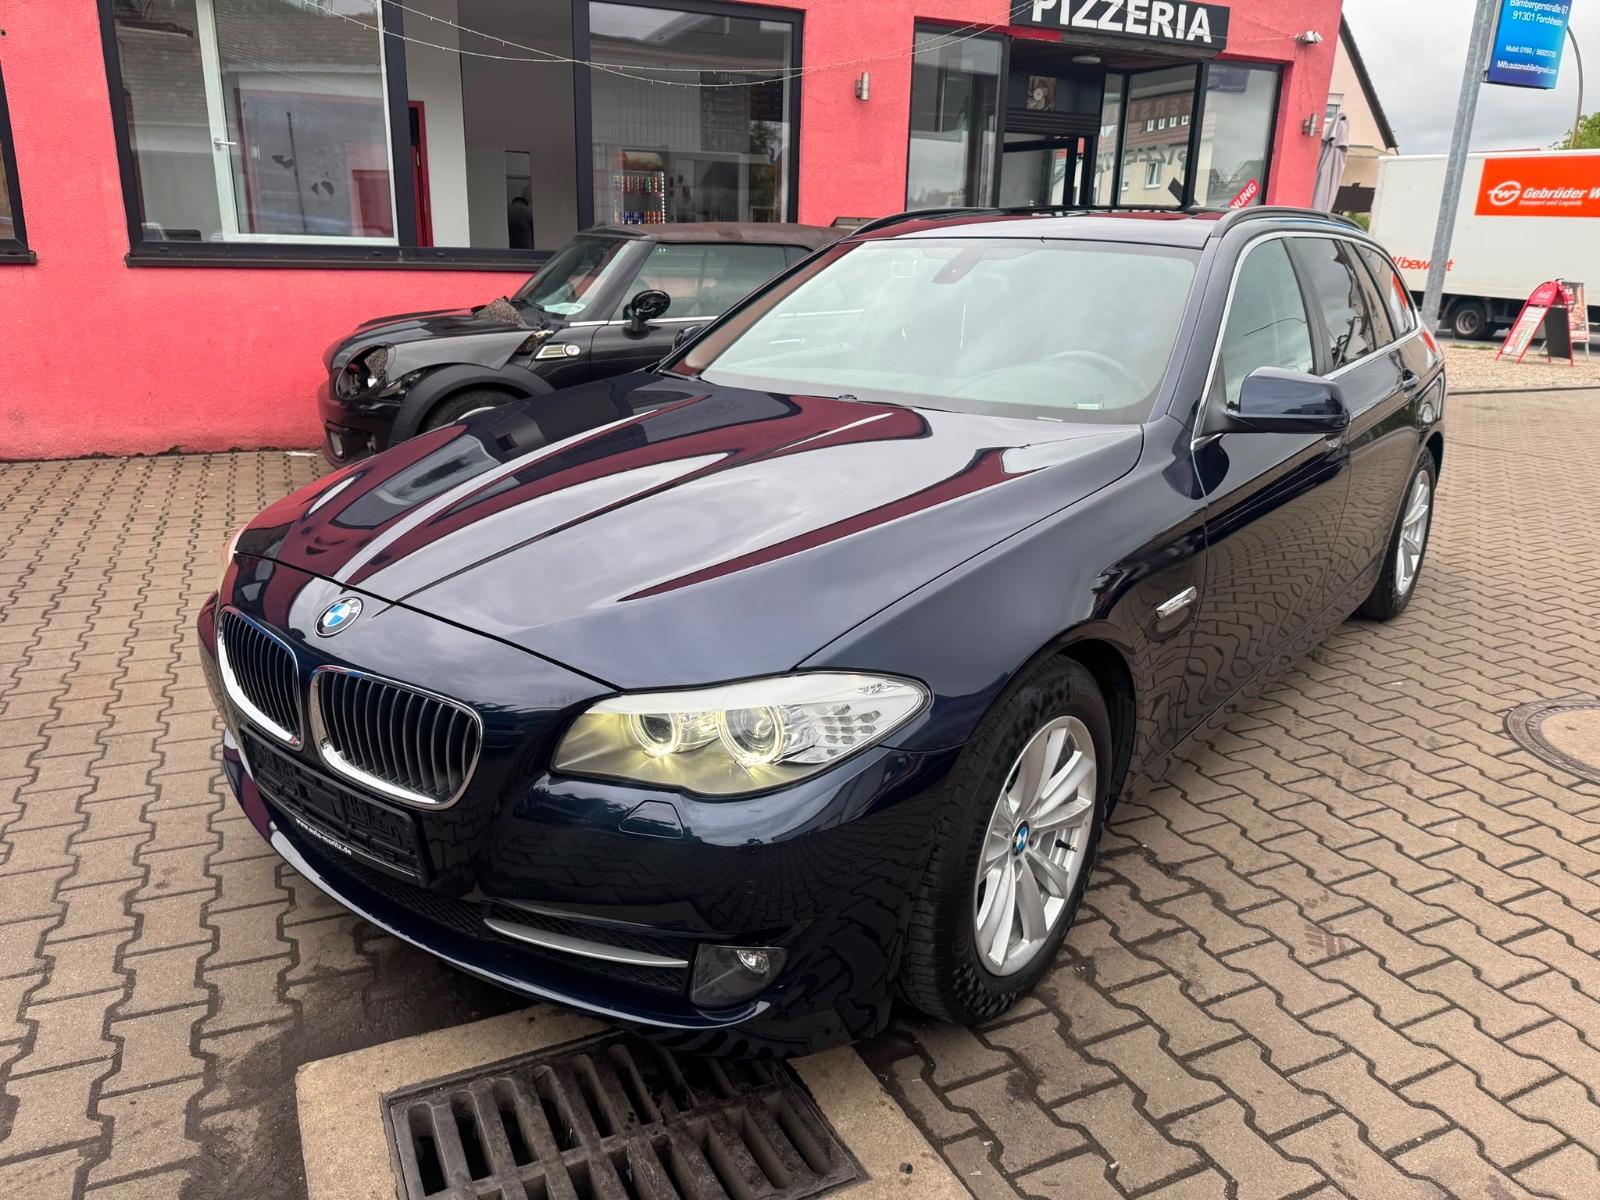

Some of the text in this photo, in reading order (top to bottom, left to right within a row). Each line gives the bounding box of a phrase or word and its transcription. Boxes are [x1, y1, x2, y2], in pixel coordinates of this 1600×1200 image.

[1032, 0, 1212, 43] PIZZERIA
[1512, 10, 1535, 21] 91301
[1523, 187, 1587, 199] Gebrüder
[1400, 257, 1455, 272] bewt
